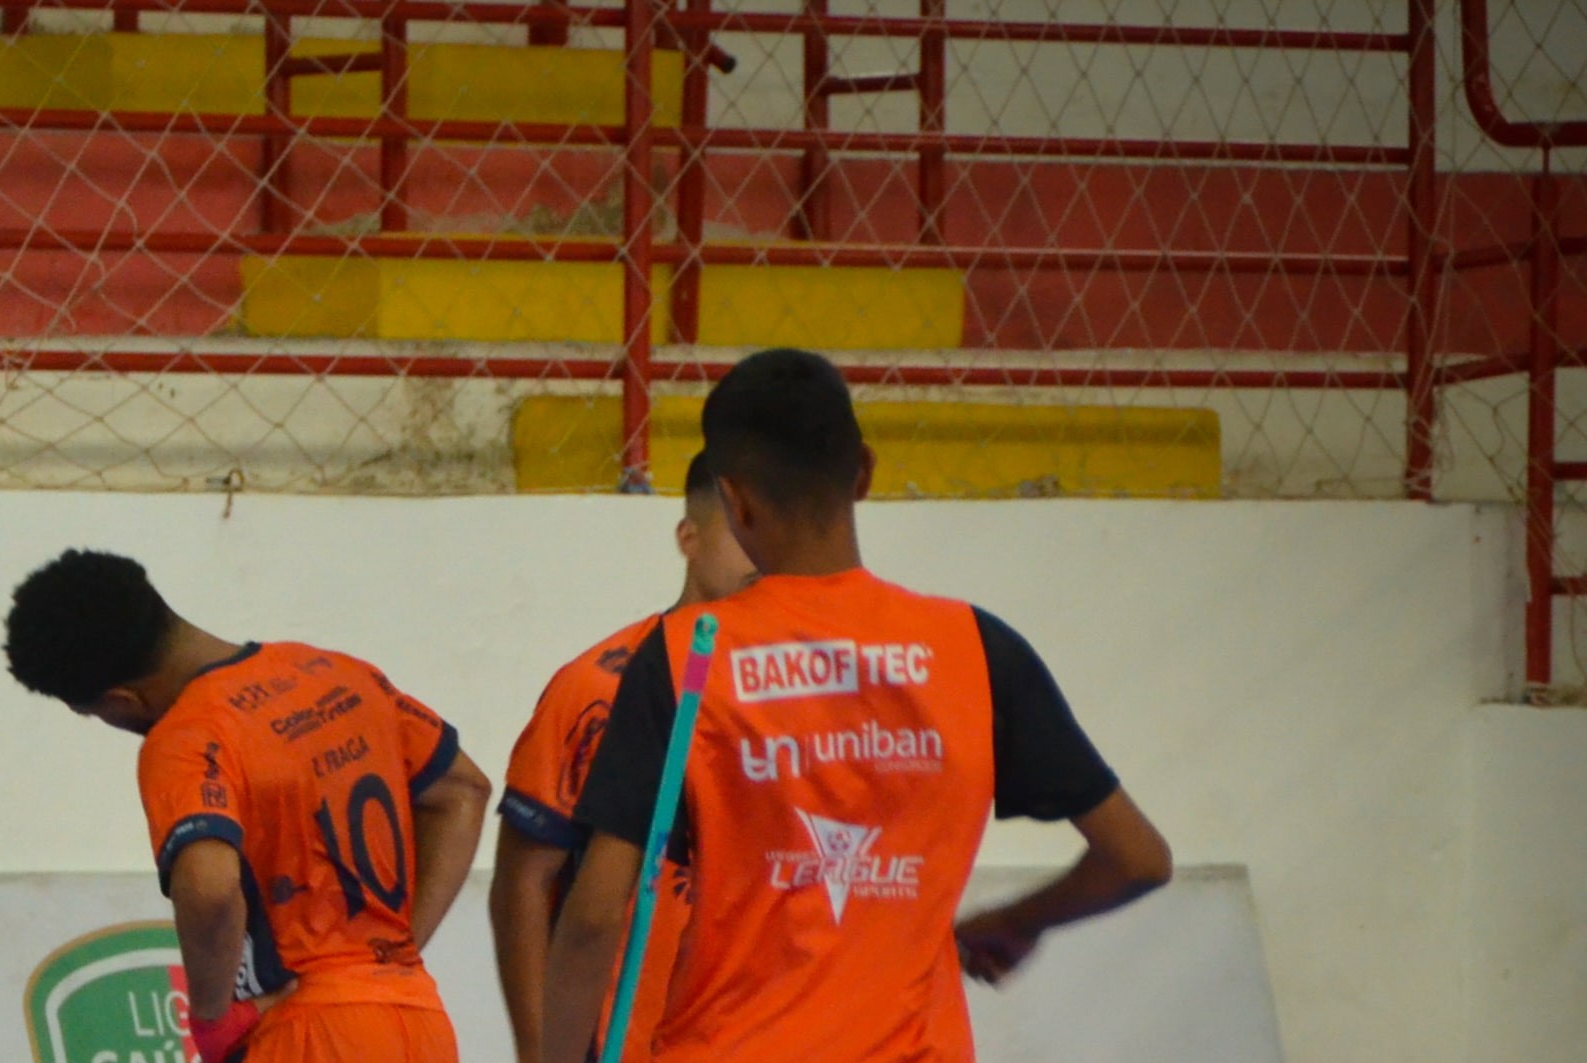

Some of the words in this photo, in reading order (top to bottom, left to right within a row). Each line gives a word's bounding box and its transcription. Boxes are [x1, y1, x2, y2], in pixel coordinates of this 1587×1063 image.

[814, 719, 943, 764] uniban
[315, 773, 406, 919] 10
[129, 990, 190, 1037] LIG
